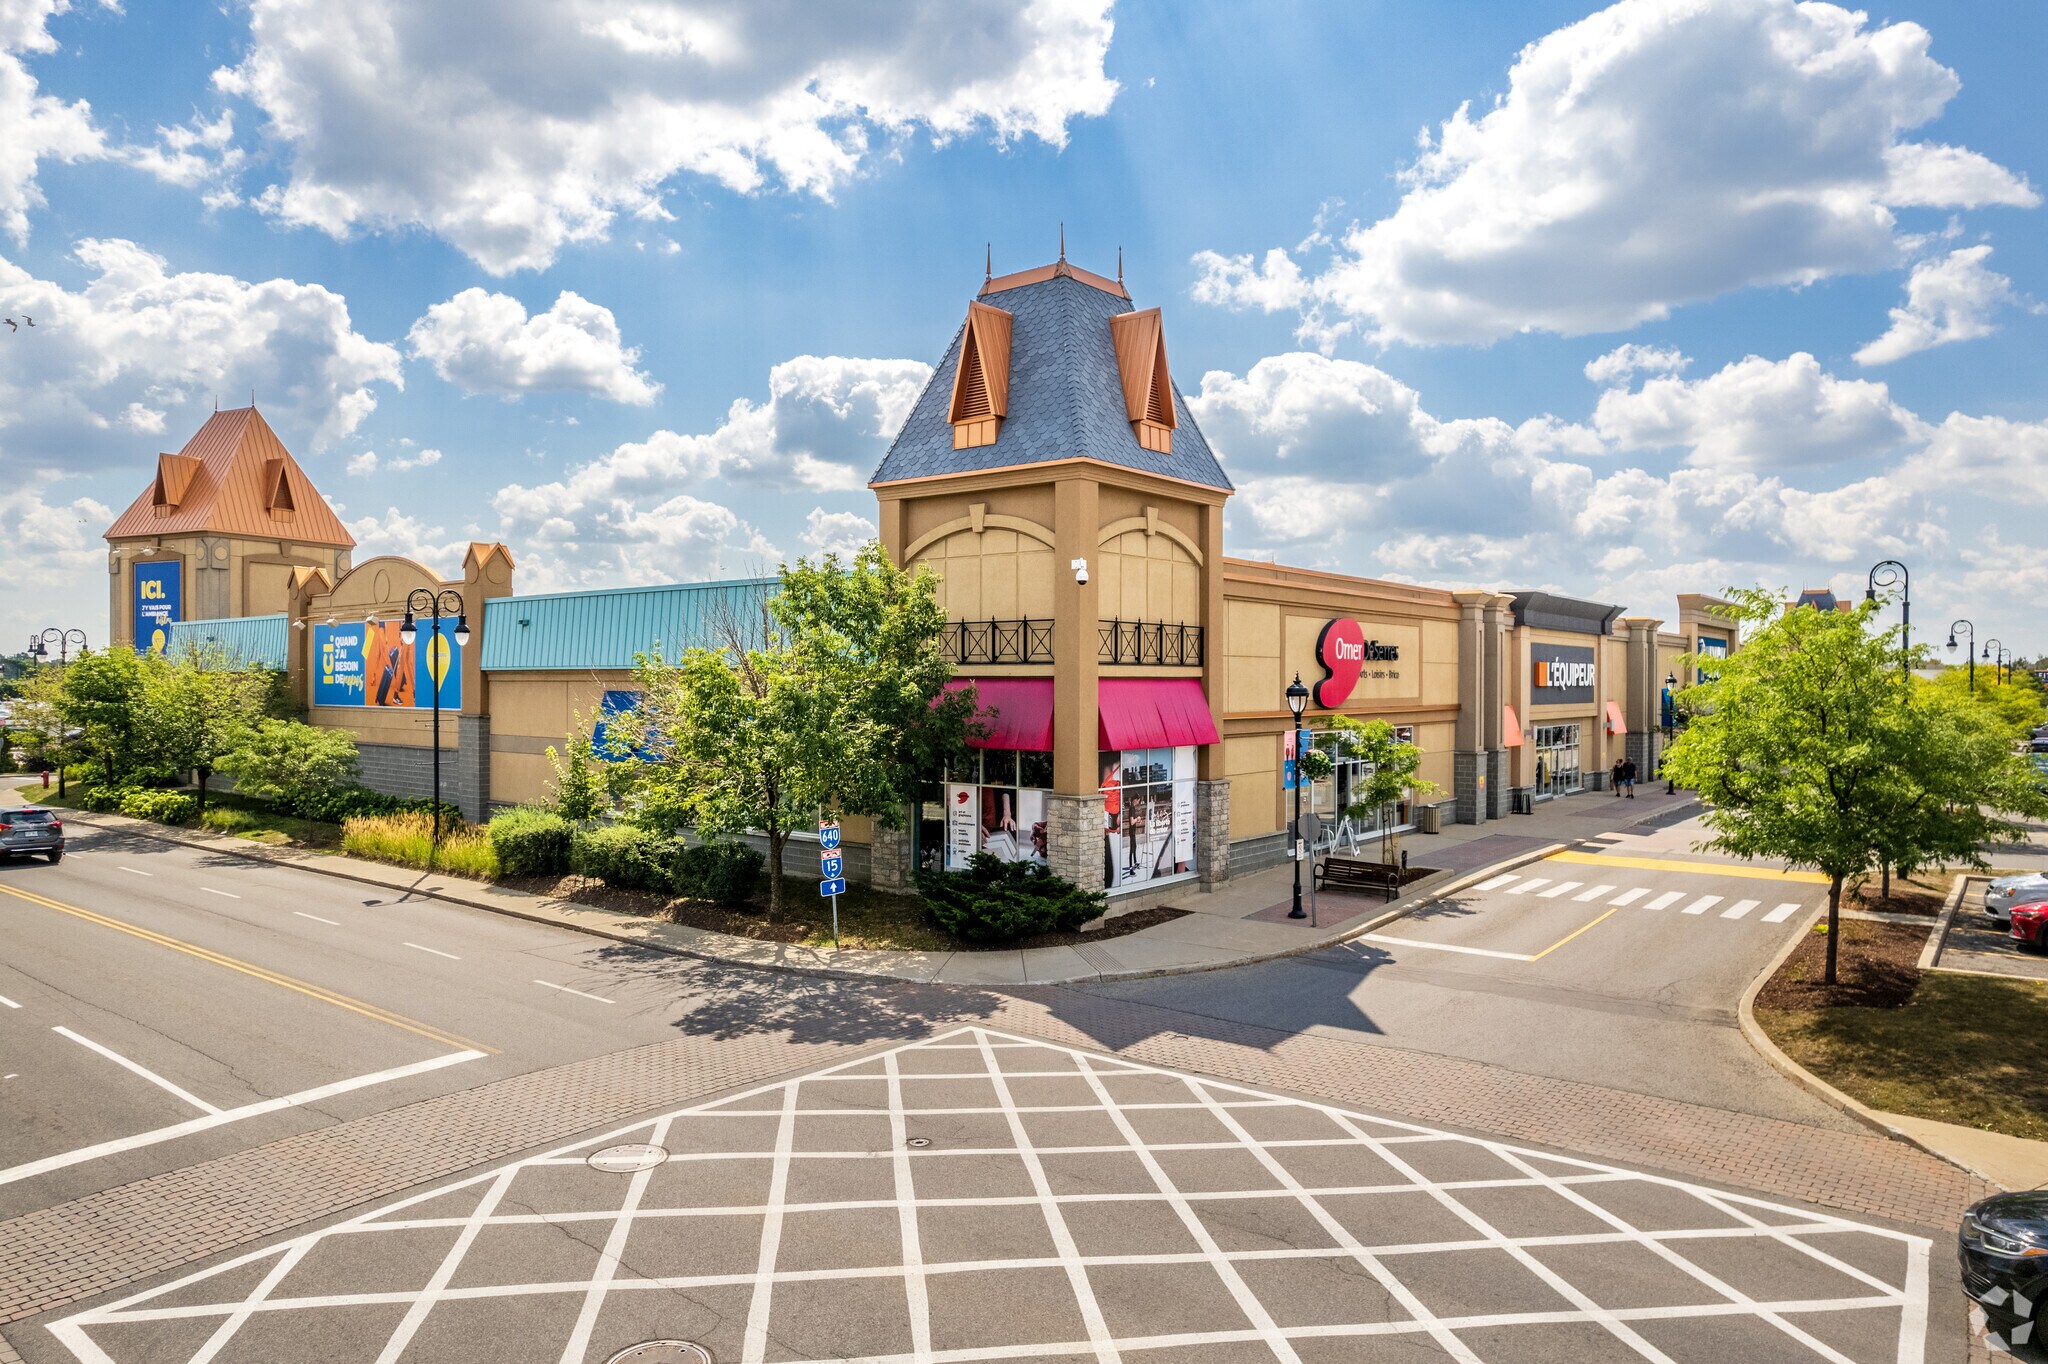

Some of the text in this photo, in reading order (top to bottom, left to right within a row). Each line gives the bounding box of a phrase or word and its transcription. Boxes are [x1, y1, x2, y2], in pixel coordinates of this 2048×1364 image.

[141, 580, 166, 599] ICI.
[335, 635, 358, 647] QUAND
[335, 649, 347, 659] J'AI
[1335, 637, 1363, 660] Omer
[335, 661, 358, 672] BESOIN
[335, 674, 344, 684] DE
[1547, 656, 1595, 691] L'ÉQUIPEUR
[822, 829, 838, 842] 640
[826, 860, 838, 871] 15
